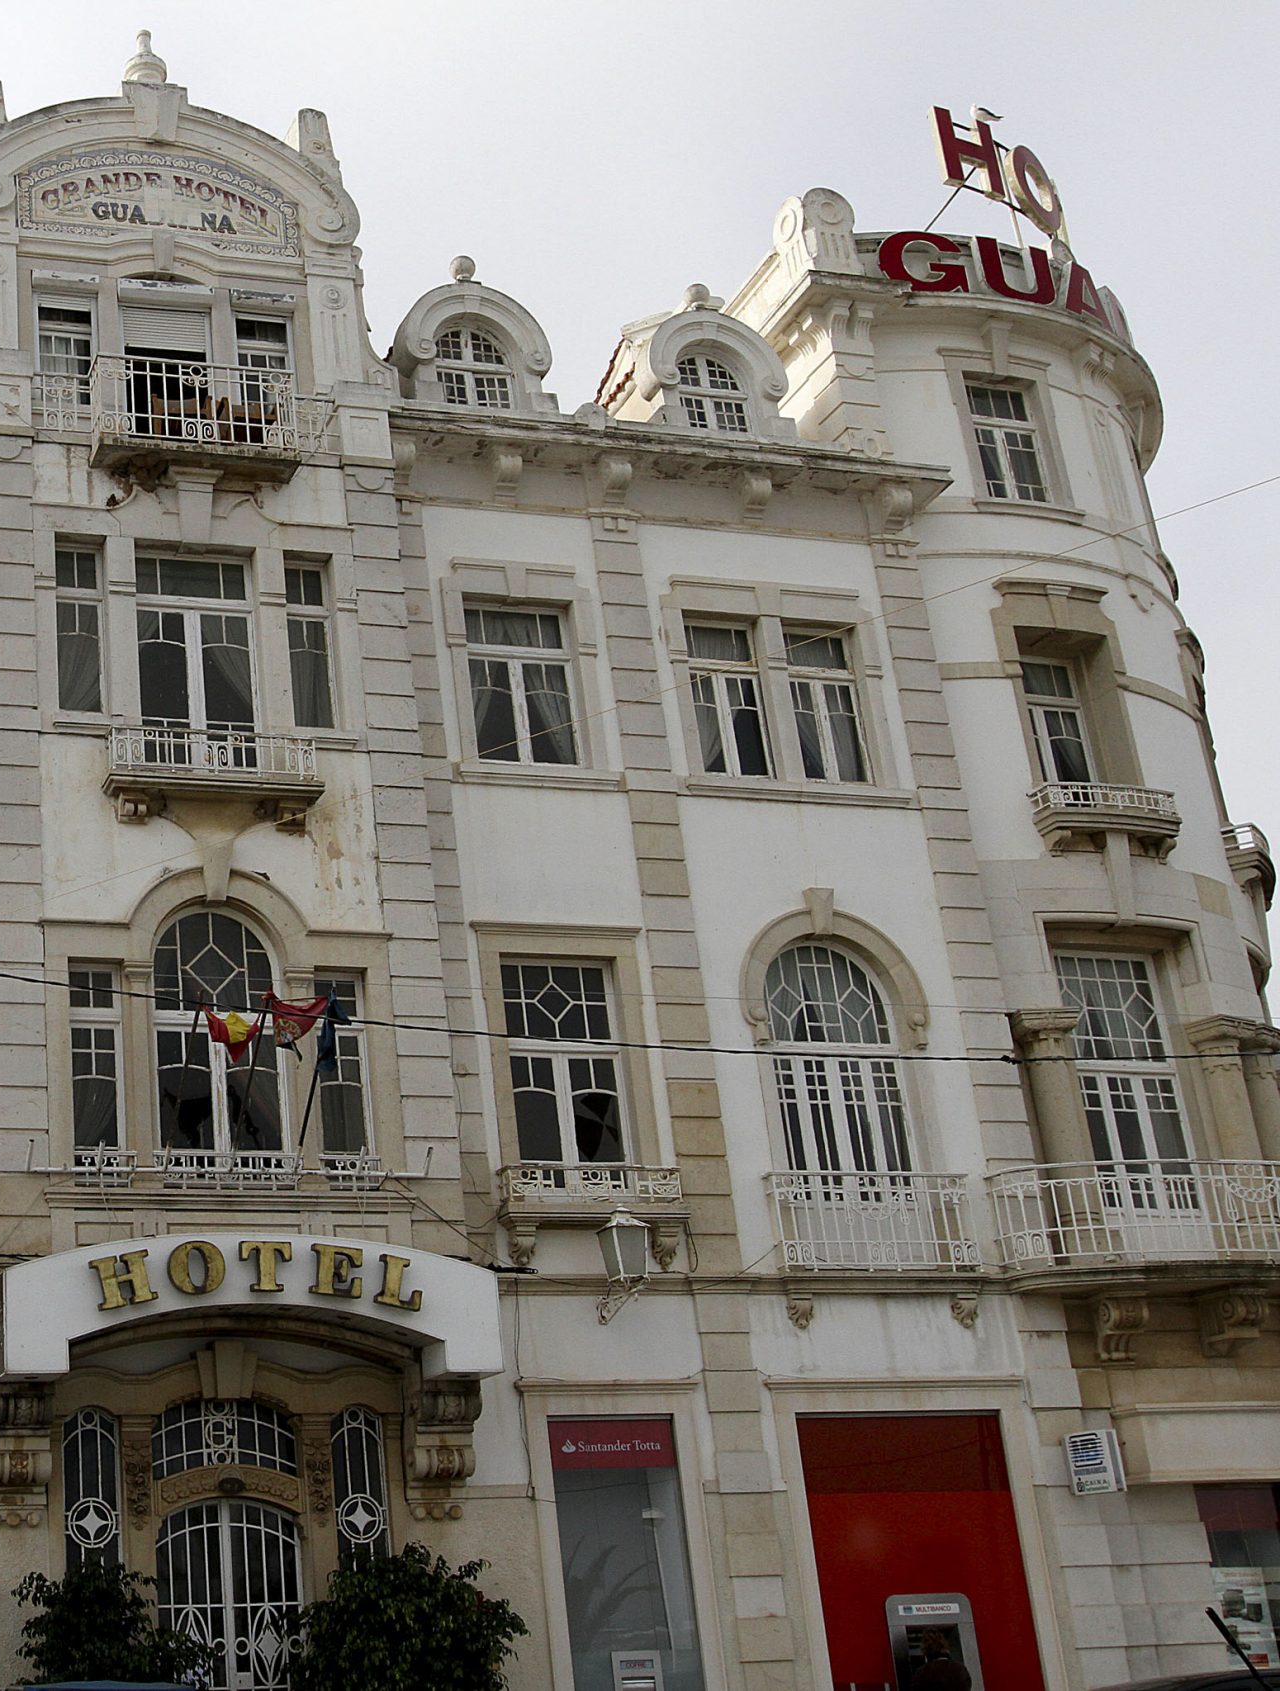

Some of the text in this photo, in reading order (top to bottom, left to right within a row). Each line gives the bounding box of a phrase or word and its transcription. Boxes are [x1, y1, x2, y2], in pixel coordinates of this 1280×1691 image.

[40, 172, 276, 232] GRANDE HOTEL
[91, 201, 237, 235] GUANA
[878, 231, 1134, 348] GUA
[88, 1240, 423, 1312] HOTEL
[578, 1440, 661, 1452] Santander Totta
[915, 1605, 952, 1613] MULTIBANCO
